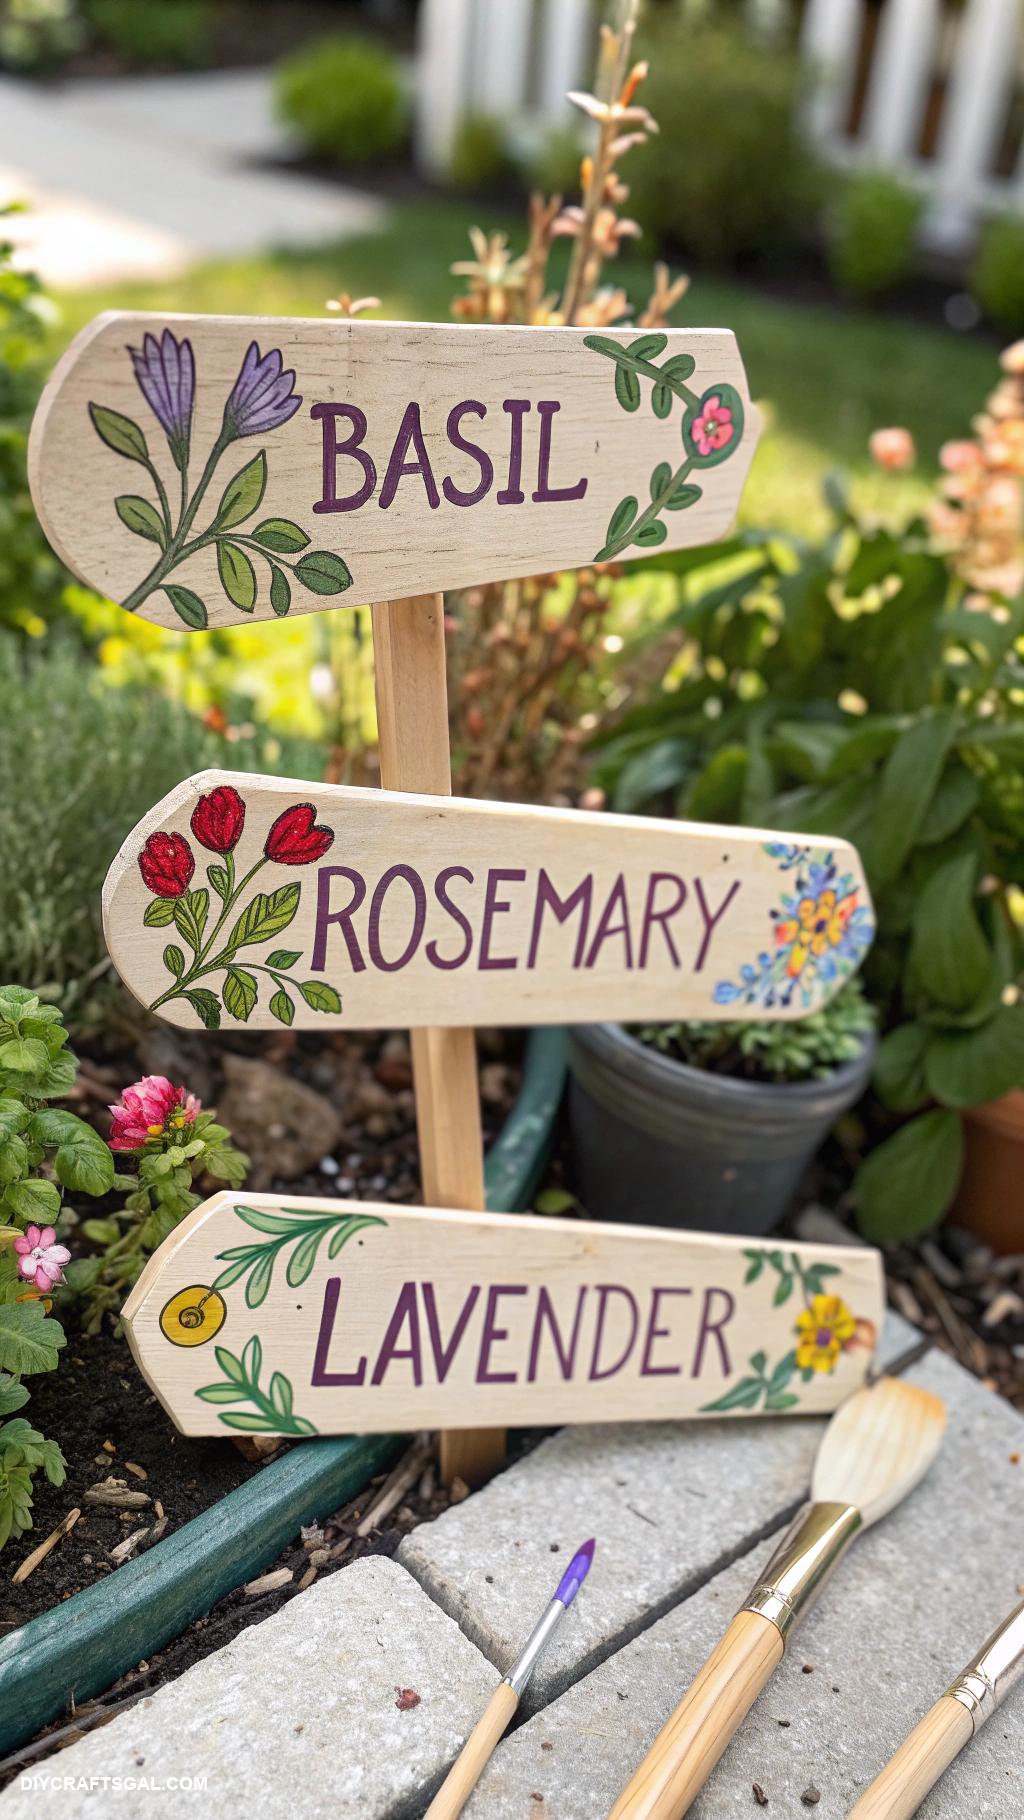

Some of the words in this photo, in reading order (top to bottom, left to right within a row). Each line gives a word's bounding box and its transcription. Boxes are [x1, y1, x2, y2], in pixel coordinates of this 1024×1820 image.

[311, 398, 589, 514] BASIL
[310, 863, 741, 973] ROSEMARY
[311, 1276, 736, 1387] LAVENDER
